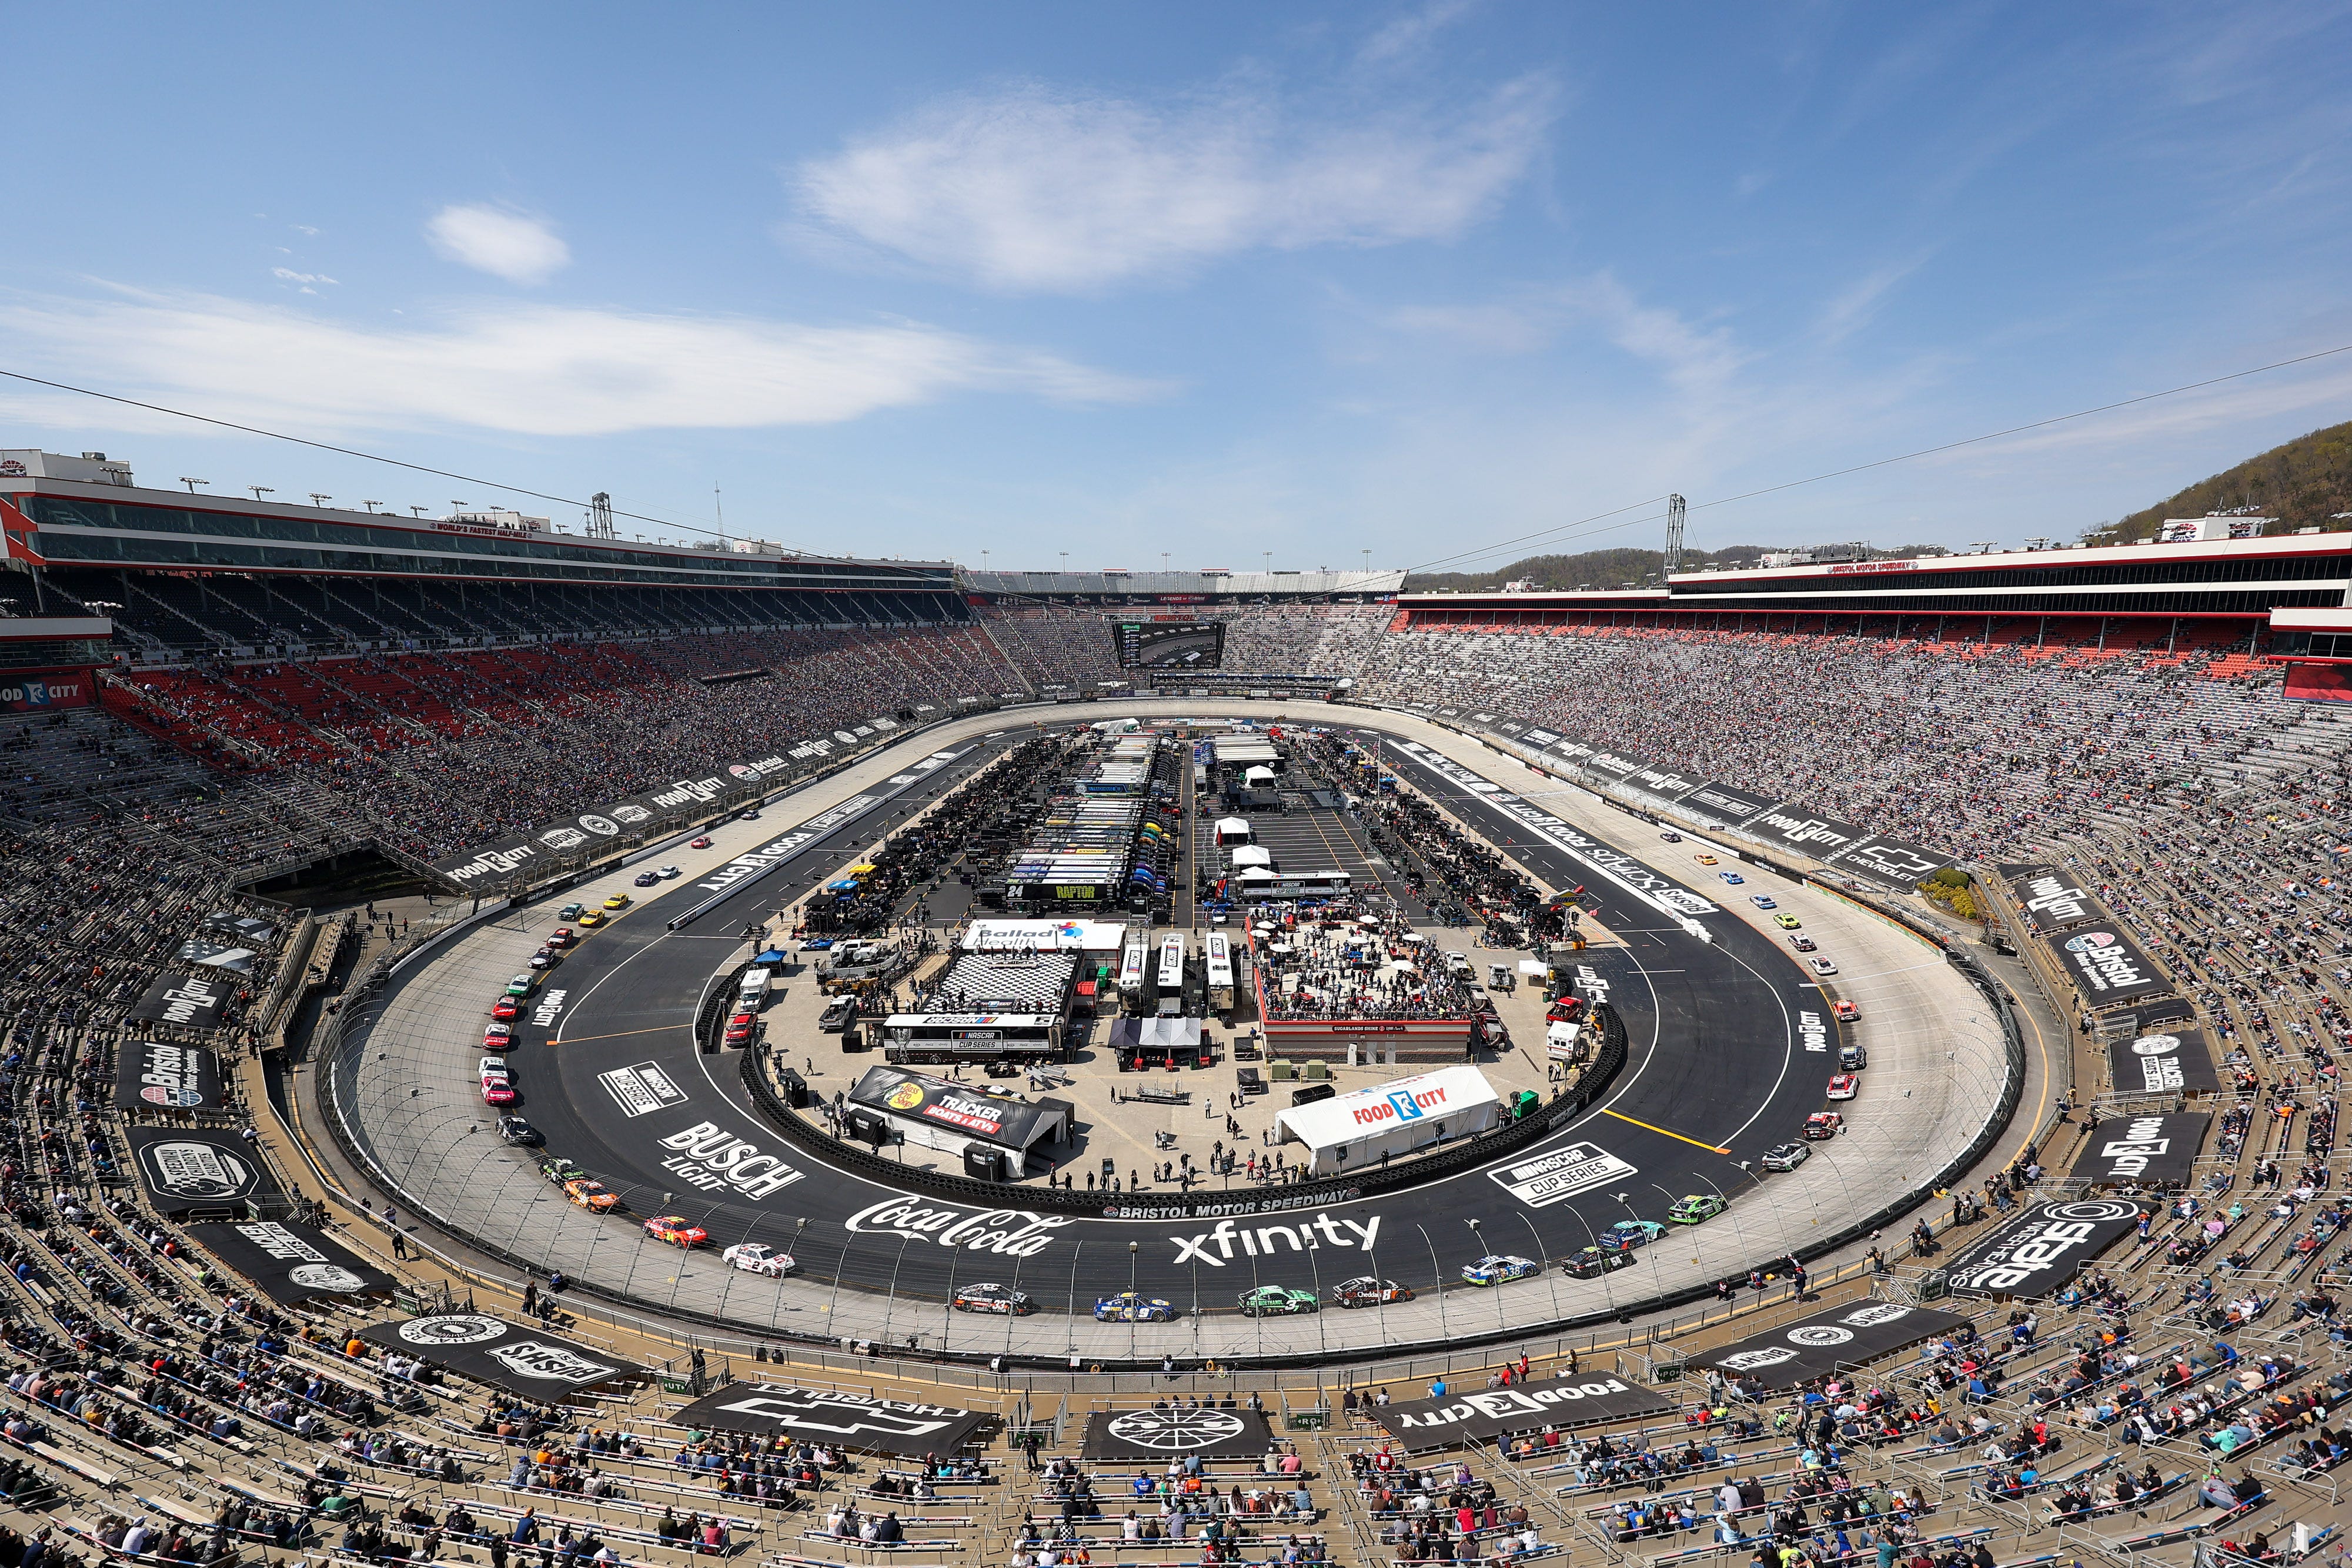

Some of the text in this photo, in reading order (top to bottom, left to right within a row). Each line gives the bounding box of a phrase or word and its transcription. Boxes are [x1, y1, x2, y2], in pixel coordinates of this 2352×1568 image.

[437, 523, 527, 539] WORLD'S FASTEST HALF-MILE
[1878, 561, 1911, 570] SPEEDWAY
[48, 685, 79, 698] CITY
[788, 739, 835, 759] FOOD CITY
[1555, 741, 1595, 757] FOOD CITY
[749, 755, 785, 771] Bristol
[1607, 757, 1642, 771] Bristol
[652, 776, 727, 807] FOOD CITY
[1636, 770, 1693, 791] FOOD CITY
[616, 807, 649, 821] BUSH'S
[1698, 791, 1756, 813] weather guard
[1504, 803, 1597, 847] FOOD CITY
[1760, 814, 1852, 847] FOOD CITY
[543, 830, 583, 847] BUSH'S
[446, 845, 536, 881] FOOD CITY
[697, 832, 814, 891] FOOD CITY
[1845, 854, 1917, 881] CHEVROLET
[1008, 885, 1095, 899] 24 RAPTOR
[1659, 890, 1706, 912] BUSH'S
[2027, 877, 2087, 921] FOOD CITY
[1664, 907, 1673, 918] FOOD
[973, 938, 1035, 946] Health
[978, 929, 1054, 938] Ballad
[2073, 952, 2109, 990] Motor Speedway
[2089, 945, 2152, 988] Bristol
[162, 978, 213, 1023] FOOD CITY
[532, 988, 568, 1027] FOOD CITY
[1805, 1011, 1827, 1052] FOOD CITY
[141, 1042, 182, 1088] Bristol
[183, 1048, 202, 1091] Motor Speedway
[2144, 1058, 2158, 1075] BOATS
[2159, 1057, 2184, 1088] TRACKER
[646, 1069, 677, 1099] NASCAR
[898, 1090, 911, 1099] Pro
[903, 1083, 920, 1095] Bass
[623, 1087, 653, 1106] SERIES
[894, 1096, 914, 1108] Shops
[1352, 1087, 1446, 1125] FOOD CITY
[927, 1107, 963, 1123] BOATS
[967, 1119, 994, 1132] ATVs
[939, 1095, 1003, 1123] TRACKER
[856, 1118, 869, 1127] Hendrick
[2108, 1117, 2165, 1178] FOOD CITY
[159, 1148, 188, 1176] SPEEDWAY
[179, 1149, 206, 1176] CHILDREN'S
[198, 1153, 222, 1176] CHARITIES
[657, 1121, 806, 1201] BUSCH
[1529, 1149, 1588, 1178] NASCAR
[660, 1156, 725, 1192] LIGHT
[1531, 1162, 1609, 1194] CUP SERIES
[1119, 1190, 1347, 1220] BRISTOL MOTOR SPEEDWAY
[235, 1225, 300, 1260] TRACKER
[1169, 1212, 1381, 1266] xfinity
[2000, 1221, 2051, 1246] WATER
[286, 1241, 322, 1259] BOATS
[1610, 1256, 1622, 1266] 54
[1972, 1222, 2096, 1289] state
[294, 1270, 317, 1285] Bass
[753, 1261, 760, 1270] 2
[1509, 1265, 1521, 1276] 38
[1949, 1246, 2015, 1288] HEATERS
[992, 1299, 1005, 1309] 33
[1285, 1299, 1297, 1310] 3
[1383, 1289, 1391, 1300] 8
[1138, 1308, 1150, 1318] 9
[1847, 1305, 1907, 1325] BUSH'S
[403, 1316, 458, 1340] BEAUTIFUL
[465, 1316, 503, 1328] BEAN
[500, 1345, 607, 1379] BUSH'S
[555, 1352, 583, 1366] BEST
[1726, 1349, 1791, 1368] BUSH'S
[748, 1384, 969, 1417] CHEVROLET
[1399, 1378, 1630, 1428] FOOD CITY
